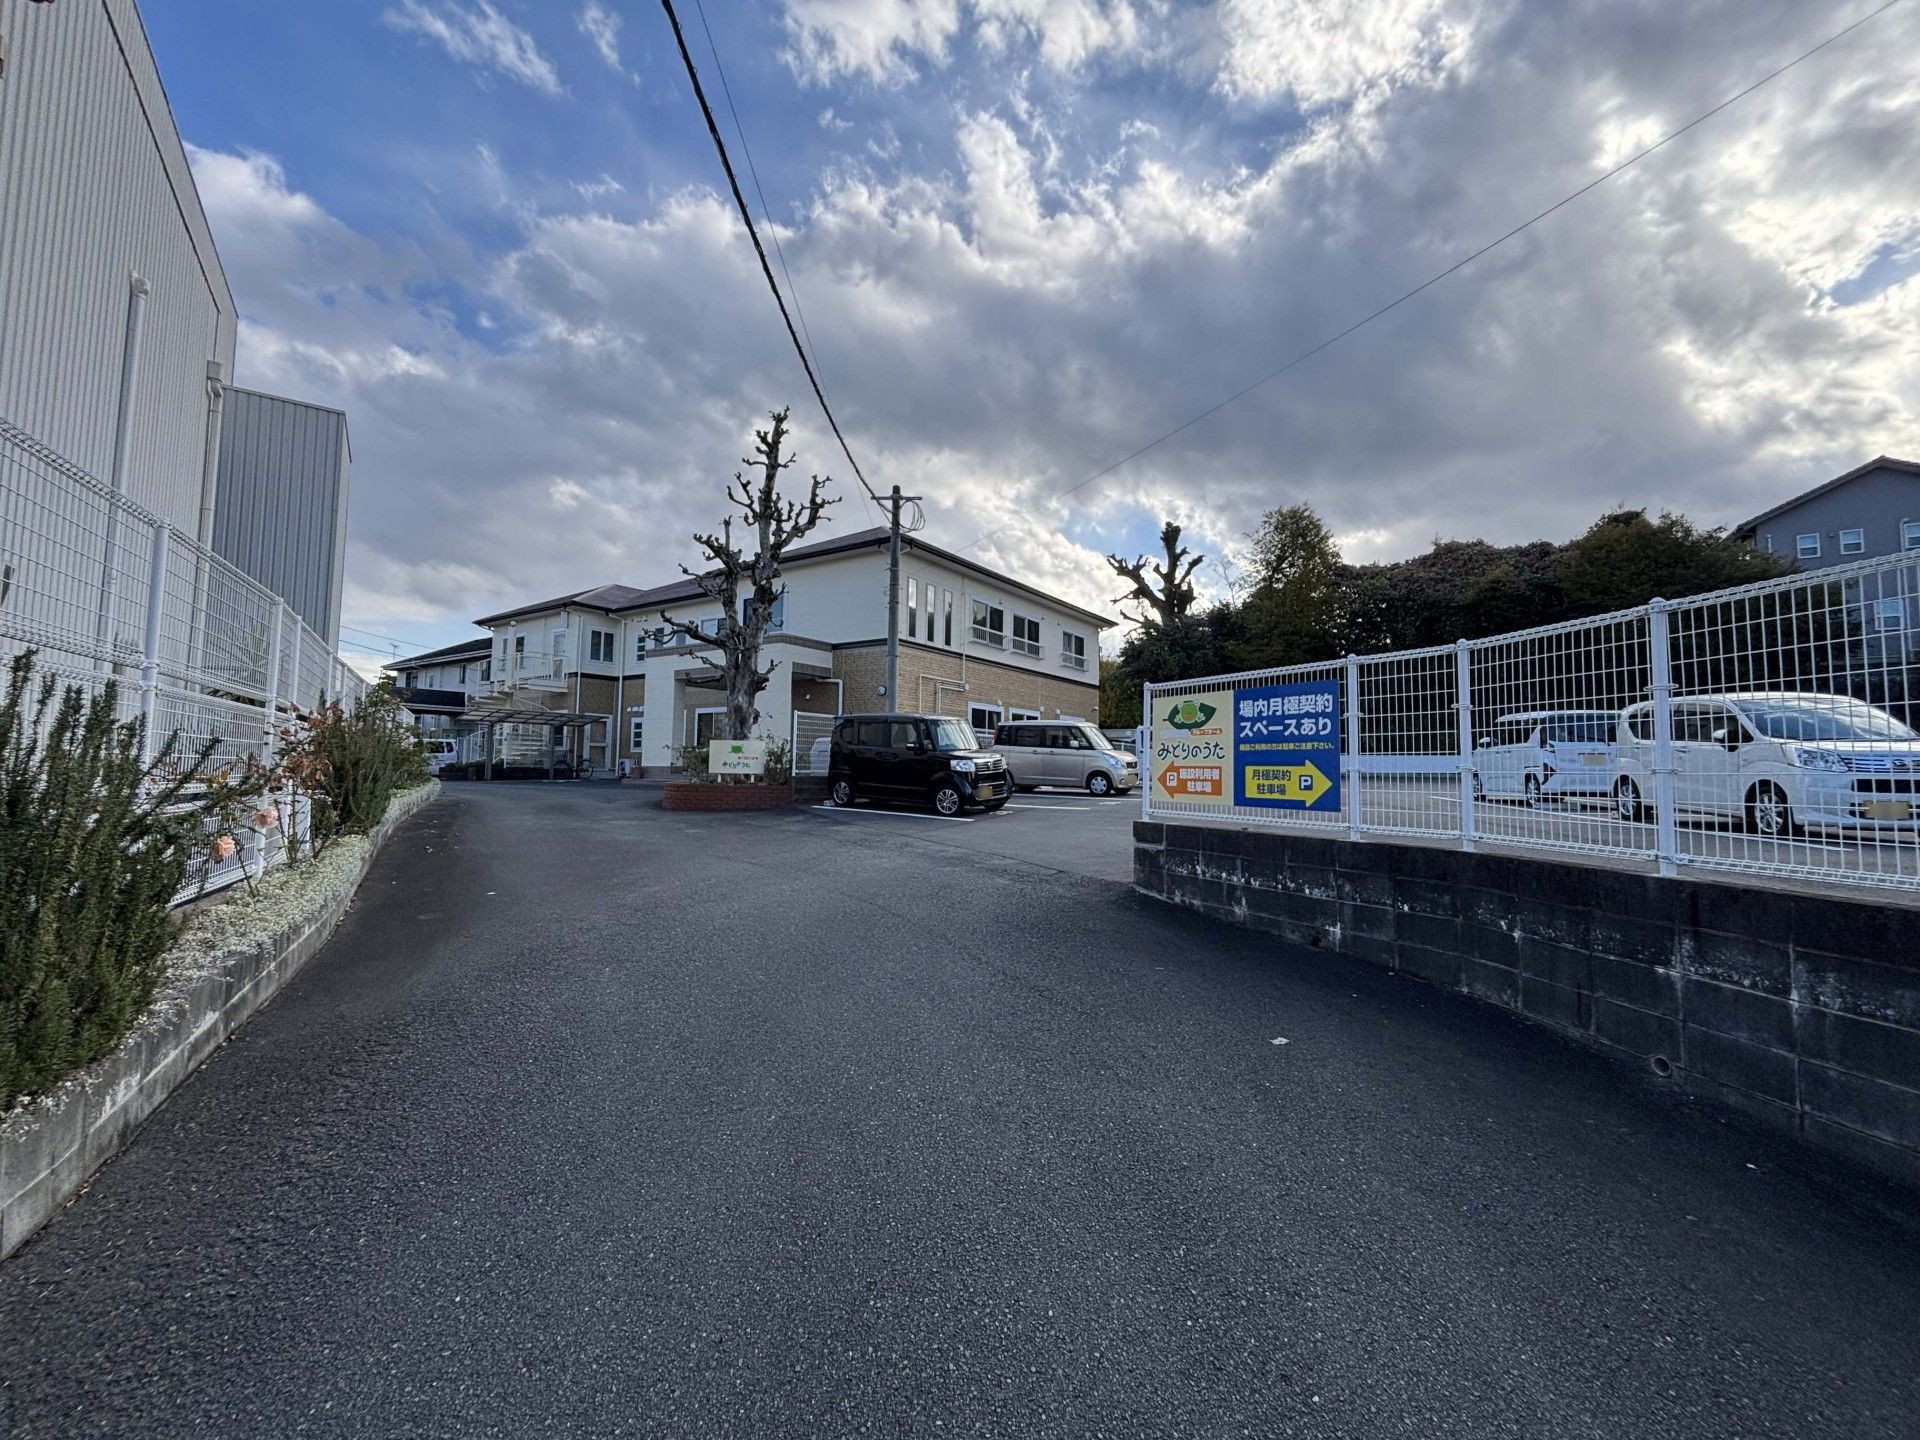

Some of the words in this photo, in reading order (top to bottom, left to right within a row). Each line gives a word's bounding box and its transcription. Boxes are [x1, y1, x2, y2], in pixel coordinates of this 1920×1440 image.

[1239, 693, 1333, 717] 場内月極契約
[1240, 717, 1332, 738] スペースあり
[1168, 774, 1176, 784] P
[1252, 769, 1291, 782] 月極契約
[1300, 776, 1312, 789] P
[1256, 784, 1287, 795] 駐車場
